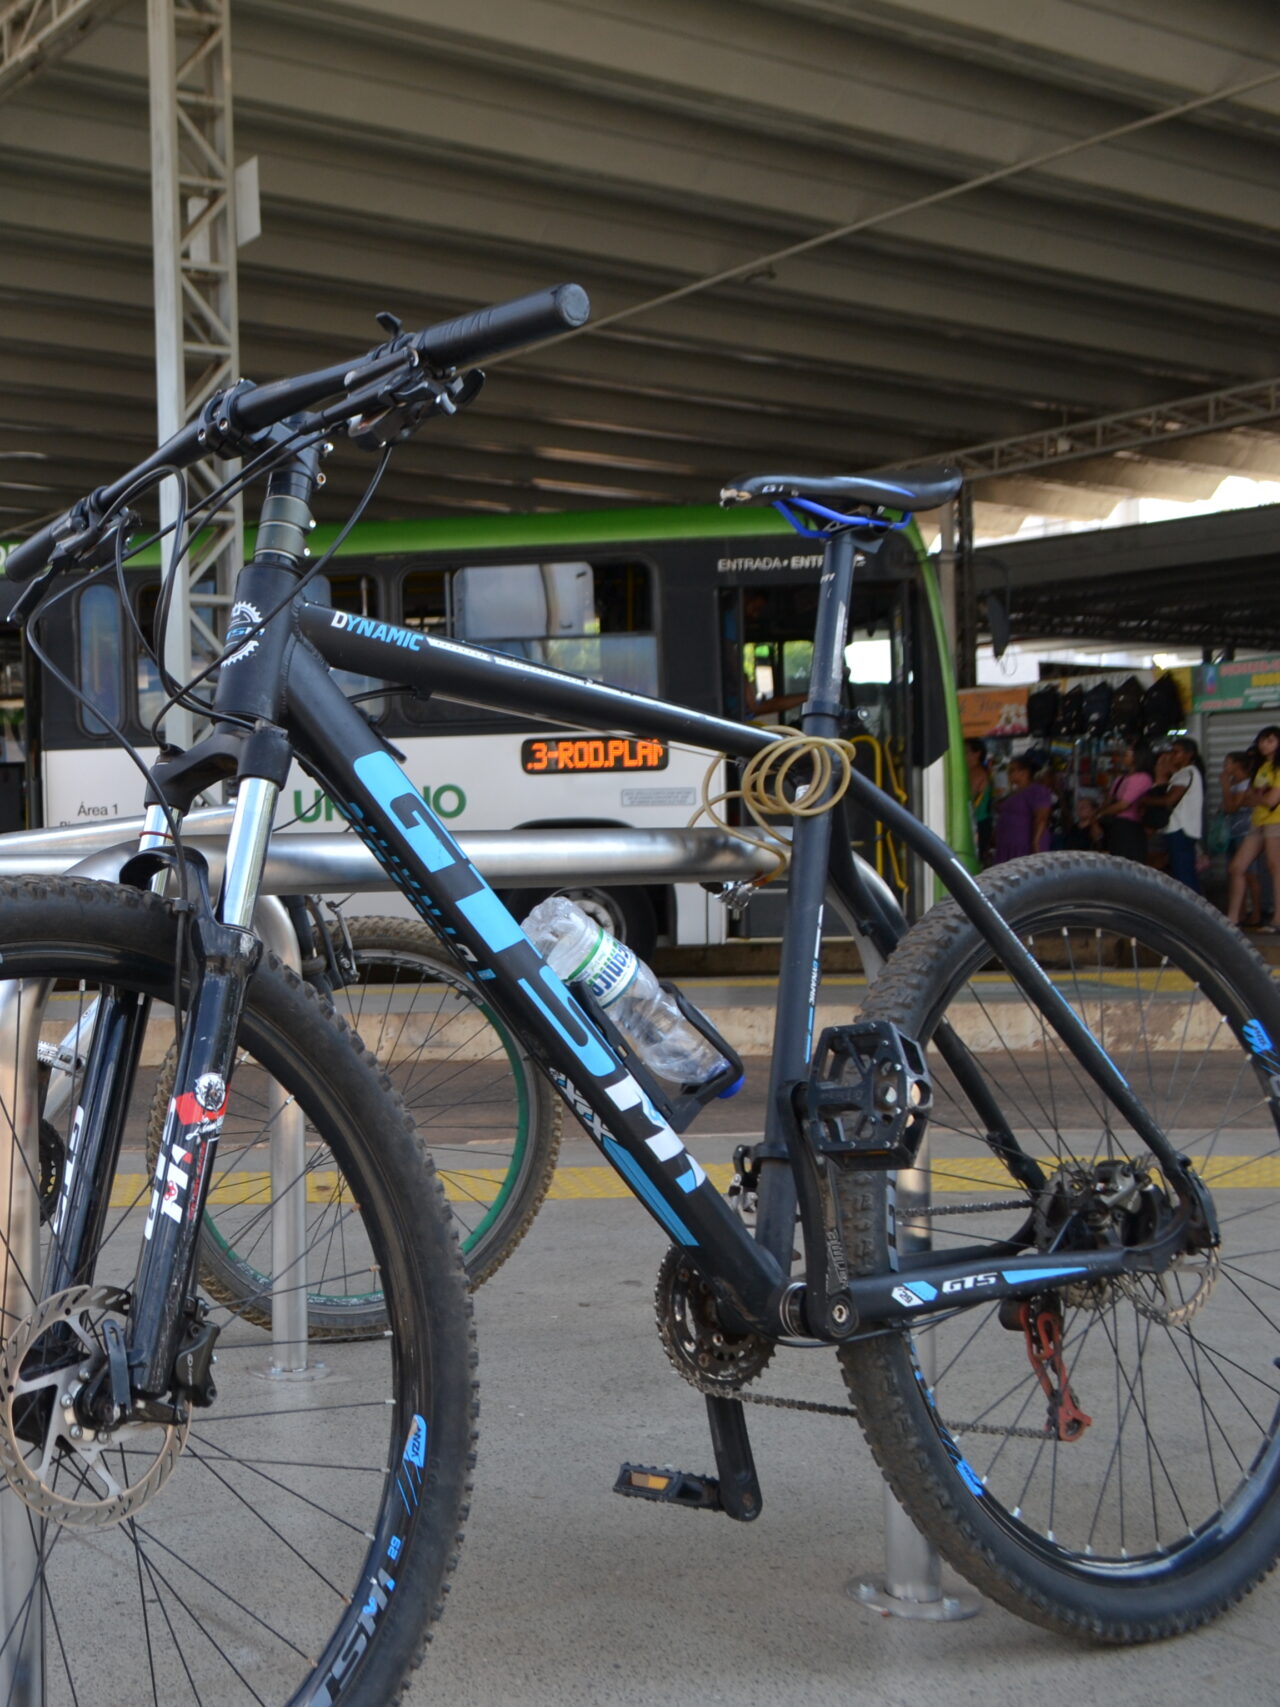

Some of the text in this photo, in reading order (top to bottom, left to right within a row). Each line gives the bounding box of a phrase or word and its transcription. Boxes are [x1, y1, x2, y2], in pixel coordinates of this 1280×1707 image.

[717, 556, 782, 572] ENTRADA
[330, 611, 425, 651] DYNAMIC
[77, 802, 118, 816] Área 1
[942, 1272, 998, 1293] GTS
